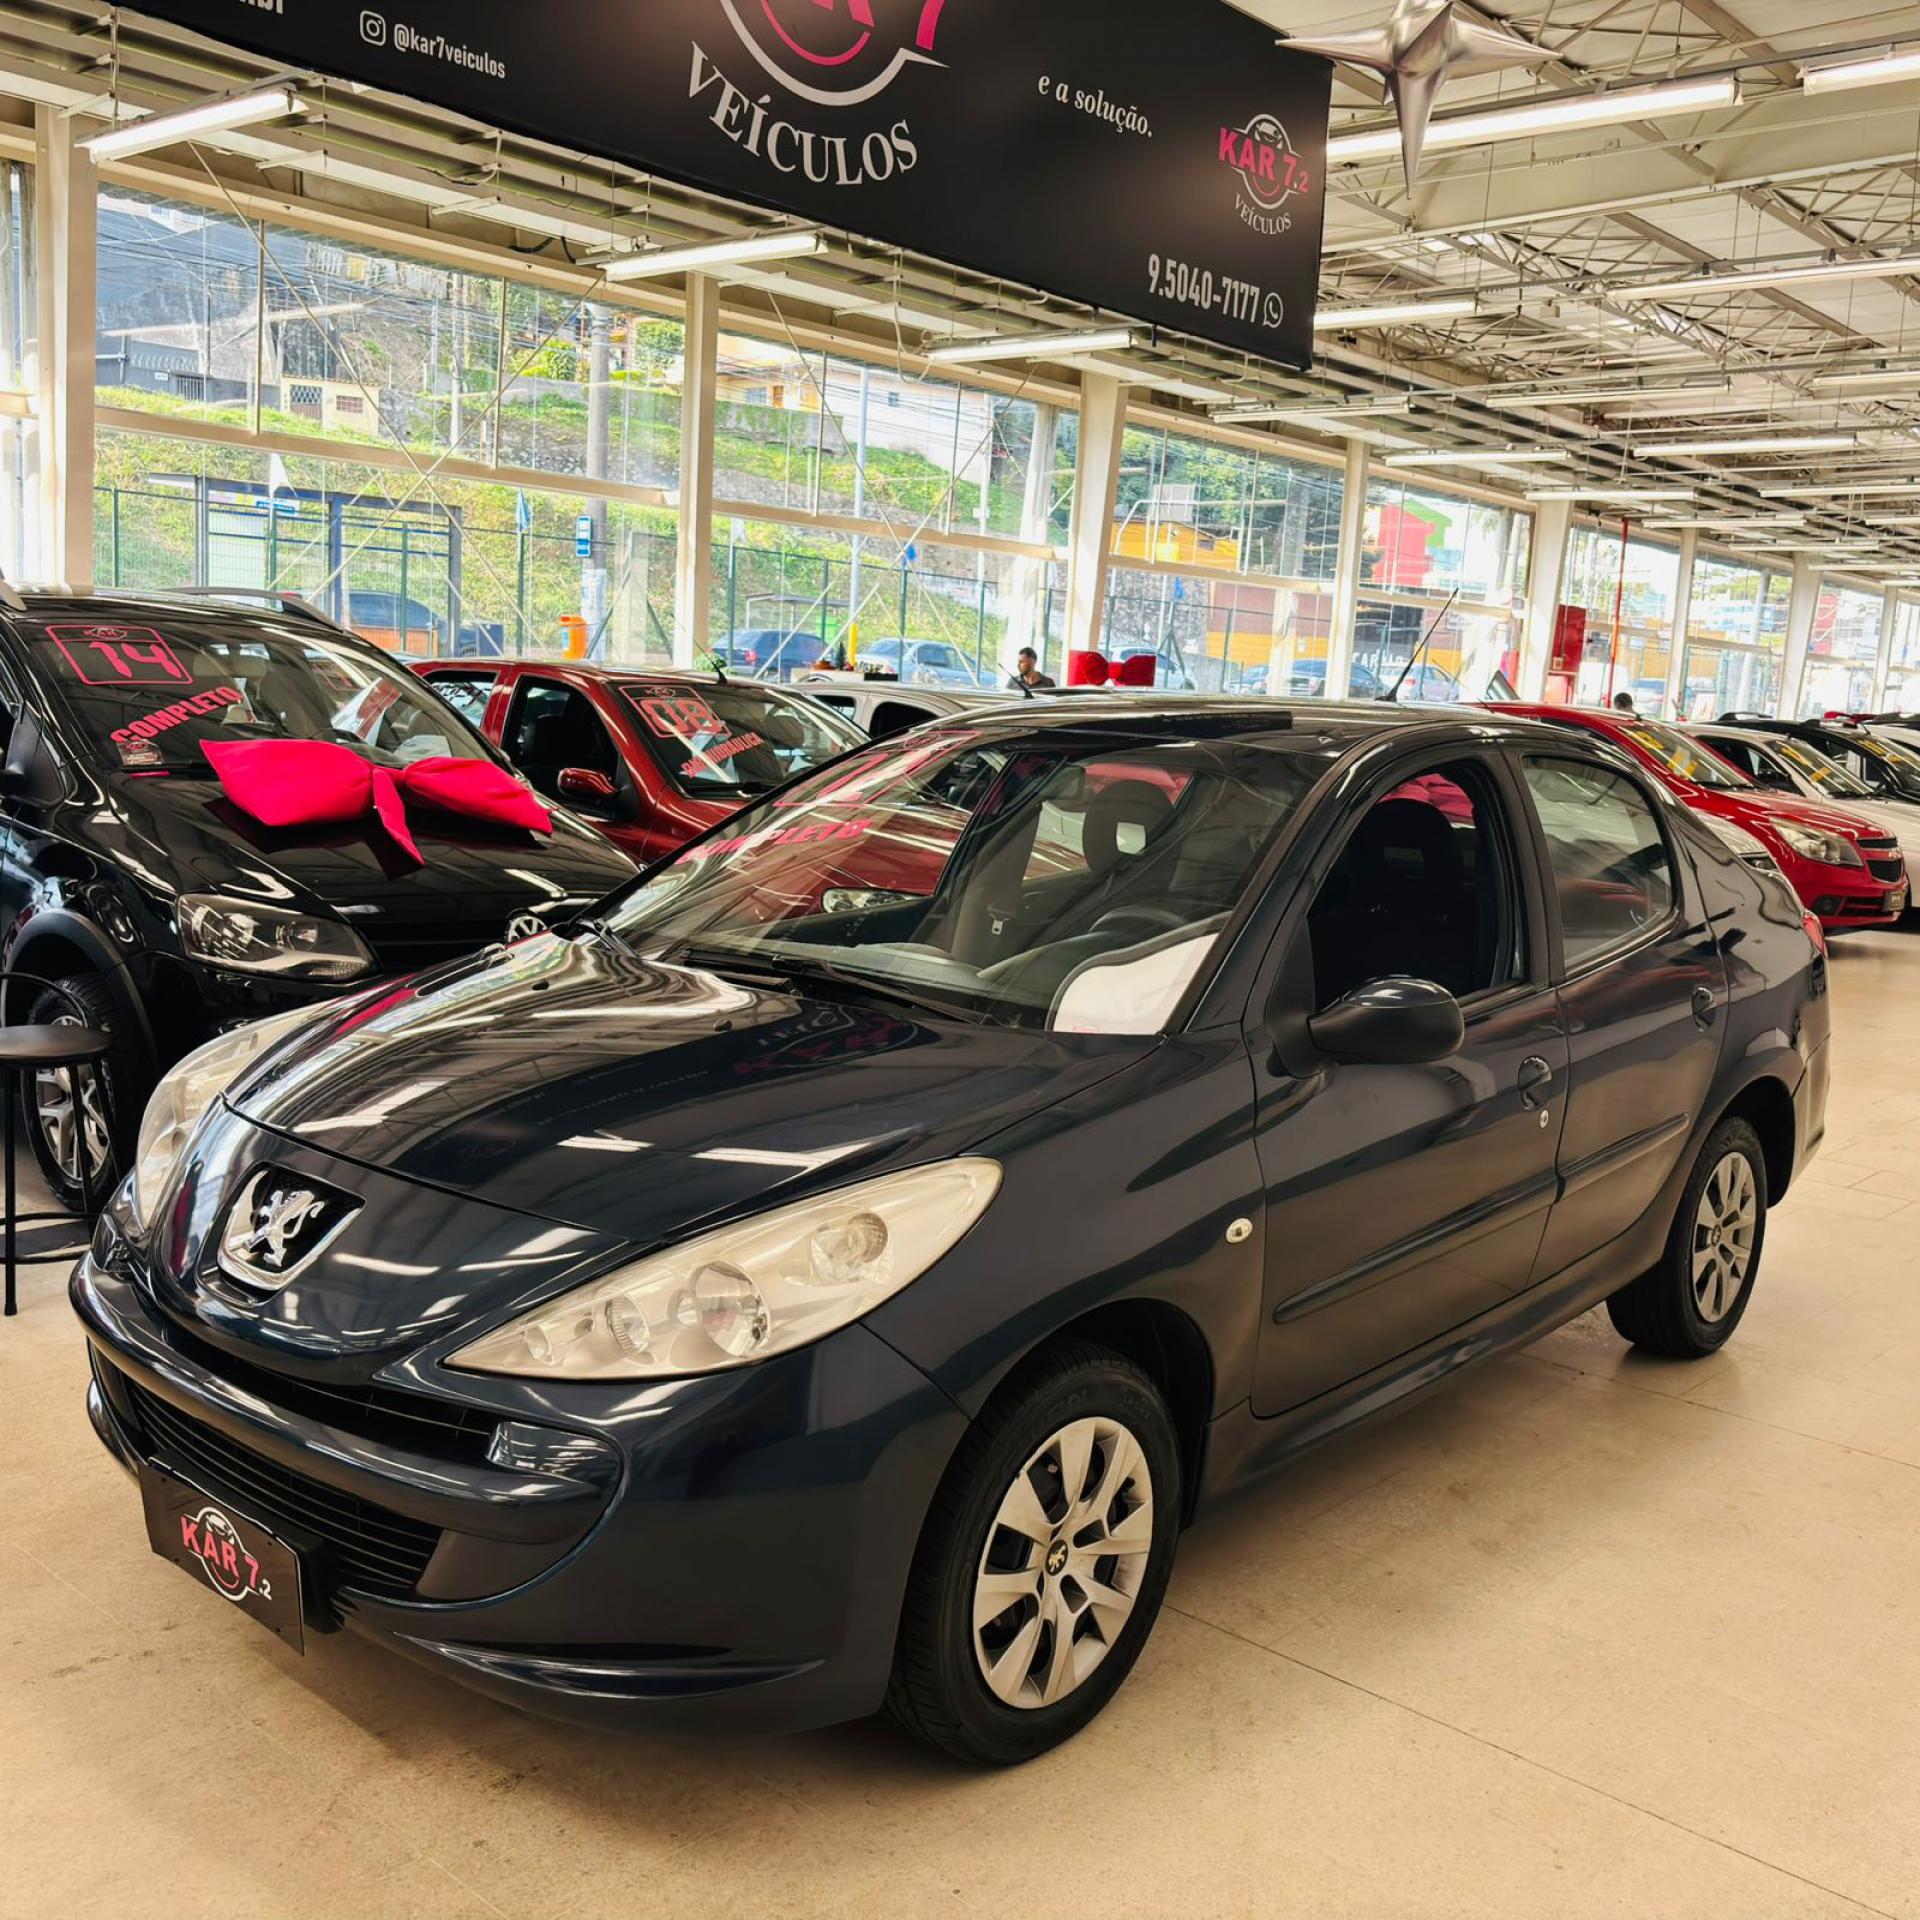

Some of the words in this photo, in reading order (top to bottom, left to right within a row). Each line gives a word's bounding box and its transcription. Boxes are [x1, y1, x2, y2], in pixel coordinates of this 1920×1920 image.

[393, 23, 506, 79] @kar7veiculos
[688, 40, 918, 186] VEÍCULOS
[1038, 75, 1051, 95] e
[1055, 82, 1069, 103] a
[1074, 89, 1153, 138] solução.
[1219, 126, 1276, 181] KAR
[1234, 192, 1292, 235] VEÍCULOS
[1148, 253, 1261, 323] 9.5040-7177
[88, 641, 183, 679] 14
[110, 686, 244, 744] COMPLETO
[640, 699, 722, 733] 08
[180, 1516, 240, 1578] KAR
